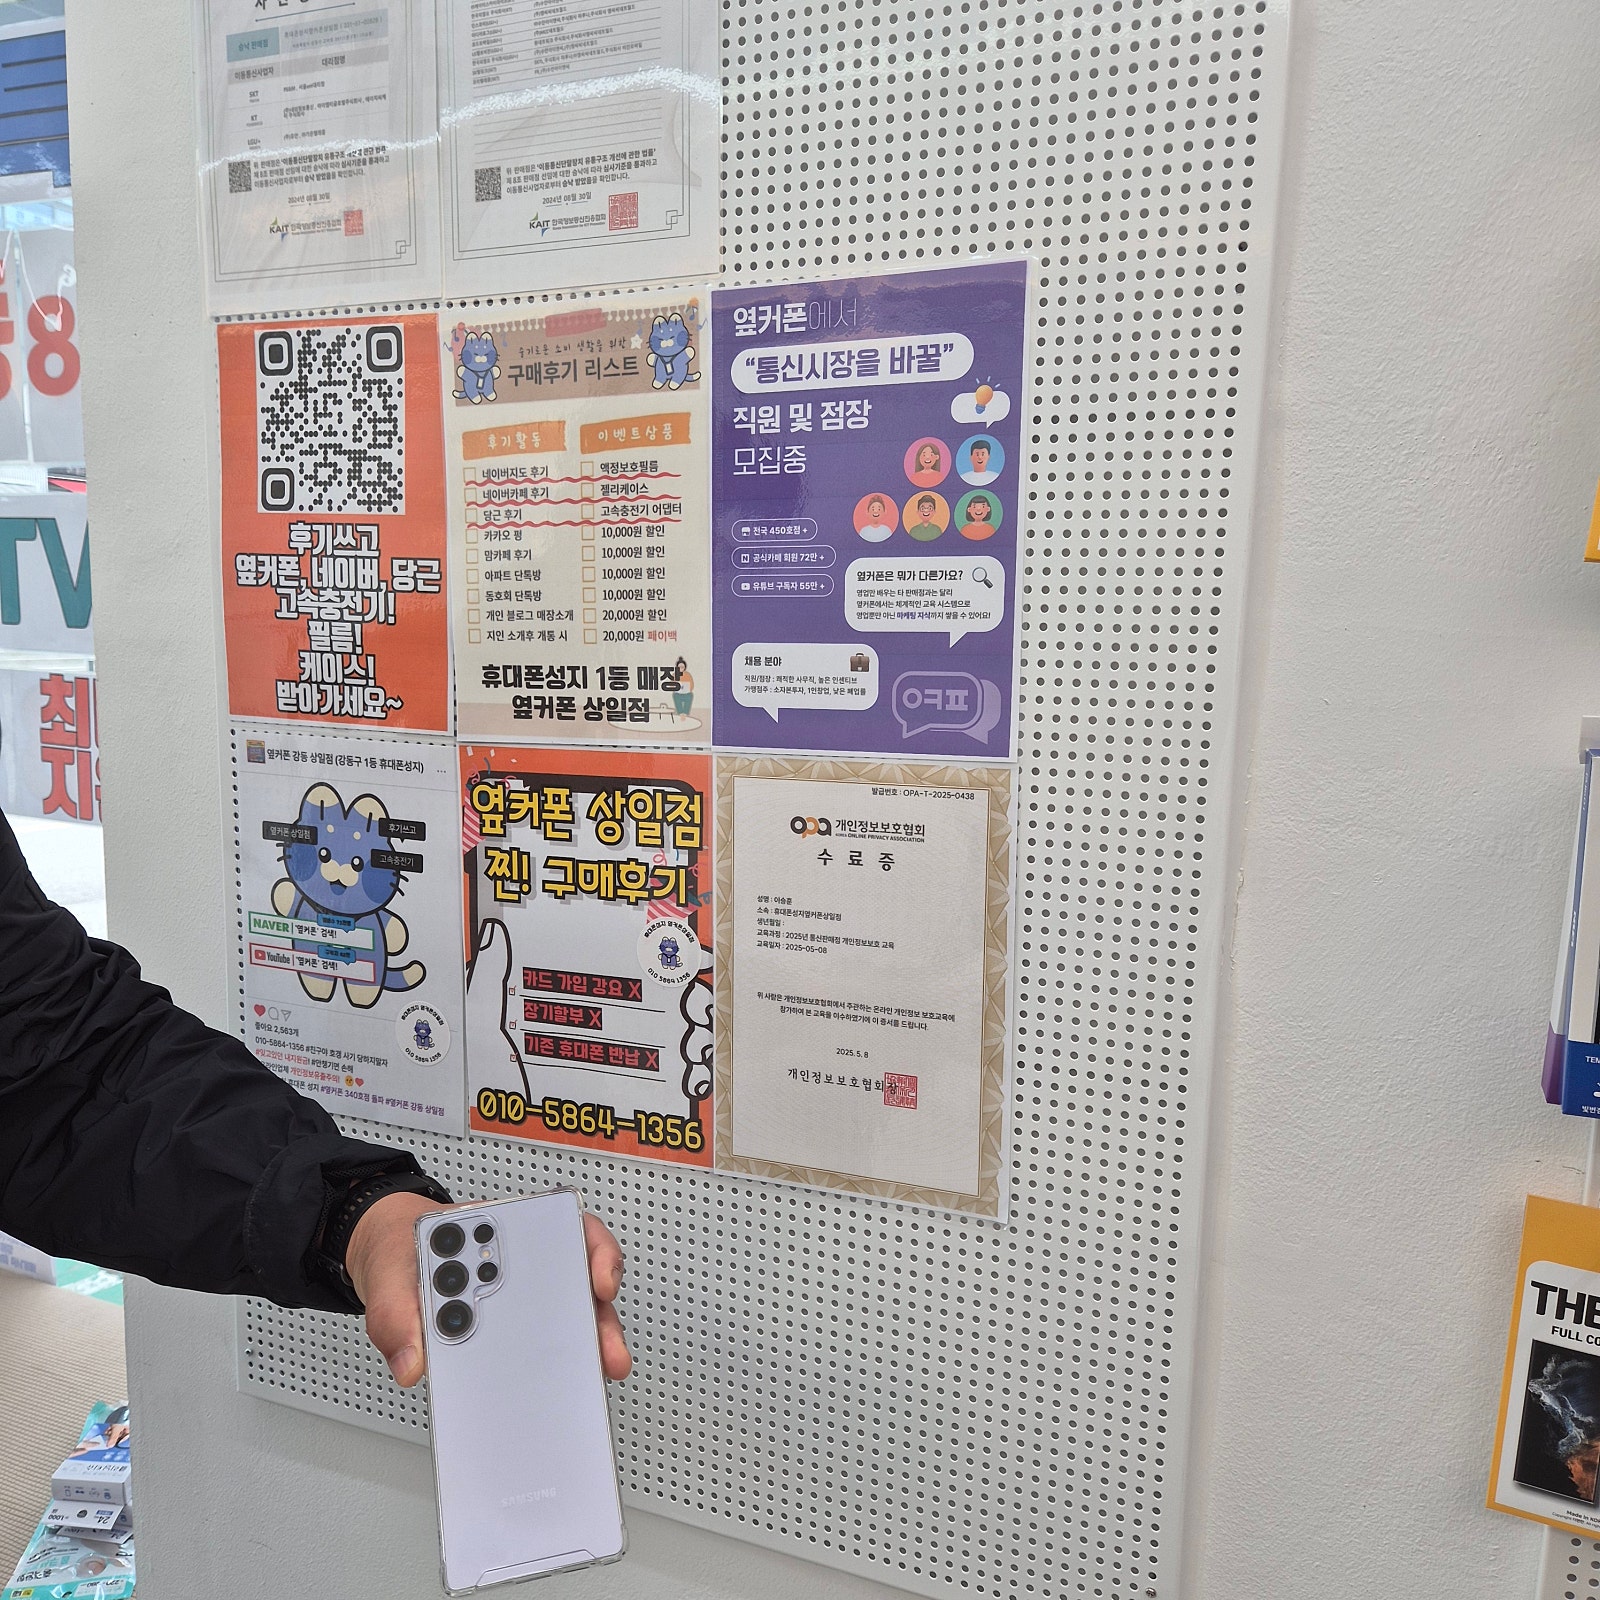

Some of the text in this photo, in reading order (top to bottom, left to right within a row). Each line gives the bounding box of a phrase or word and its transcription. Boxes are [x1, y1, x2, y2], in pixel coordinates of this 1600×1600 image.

[270, 226, 289, 234] KAIT
[529, 220, 550, 229] KAIT
[733, 298, 858, 337] 옆커폰에서
[507, 356, 640, 386] 구매후기 리스트
[733, 400, 872, 434] 직원 및 점장
[600, 460, 659, 474] 액정보호필름
[733, 445, 807, 476] 모집중
[482, 466, 548, 480] 네이버지도 후기
[483, 487, 549, 501] 네이버카페 후기
[601, 482, 649, 496] 젤리케이스
[484, 509, 522, 521] 당근 후기
[601, 502, 682, 517] 고속충전기 어댑터
[484, 530, 511, 542] 카카오
[601, 525, 665, 538] 10,000원 할인
[753, 526, 800, 536] 전국 450호점
[288, 520, 380, 557] 후기쓰고
[484, 549, 532, 561] 맘카페 후기
[601, 545, 665, 559] 10,000원 할인
[753, 553, 817, 562] 공식카페 회원 72만
[0, 517, 92, 629] TV
[235, 553, 441, 593] 옆커폰, 네이버, 당근
[484, 569, 541, 581] 아파트 단톡방
[601, 567, 666, 580] 10,000원 할인
[857, 570, 963, 581] 옆커폰은 뭐가 다른가요?
[753, 582, 774, 590] 유튜브
[776, 582, 798, 590] 구독자
[485, 590, 542, 602] 동호회 단톡방
[602, 588, 666, 601] 10,000원 할인
[275, 588, 396, 625] 고속충전기!
[486, 610, 574, 622] 개인 블로그 매장소개
[602, 609, 667, 622] 20,000원 할인
[308, 620, 363, 654] 필름!
[487, 630, 568, 642] 지인 소개후 개통 시
[602, 630, 677, 643] 20,000원 페이백
[299, 650, 375, 686] 케이스!
[744, 656, 782, 666] 채용 분야
[481, 664, 683, 692] 휴대폰성지 1등 매장
[276, 680, 404, 719] 받아가세요~
[40, 673, 98, 748] 최
[583, 697, 650, 723] 상일점
[267, 749, 424, 774] 옆커폰 강동 상일점 (강동구 1등 휴대폰성지)
[41, 746, 102, 821] 지
[872, 787, 975, 800] 발급번호 OPA-T-2025-0438
[471, 781, 703, 849] 옆커폰 상일점
[388, 823, 416, 835] 후기쓰고
[835, 819, 925, 837] 개인정보보호협회
[485, 848, 689, 906] 찐! 구매후기
[253, 918, 289, 932] NAVER
[785, 943, 828, 954] 2025-05-08
[267, 952, 290, 964] YouTube
[523, 969, 642, 999] 카드 가입 강요 X
[524, 1002, 601, 1027] 장기할부 X
[525, 1035, 659, 1069] 기존 휴대폰 반납 X
[478, 1088, 703, 1151] 010-5864-1356
[1551, 1326, 1582, 1342] FULL
[500, 1487, 558, 1507] SAMSUNG
